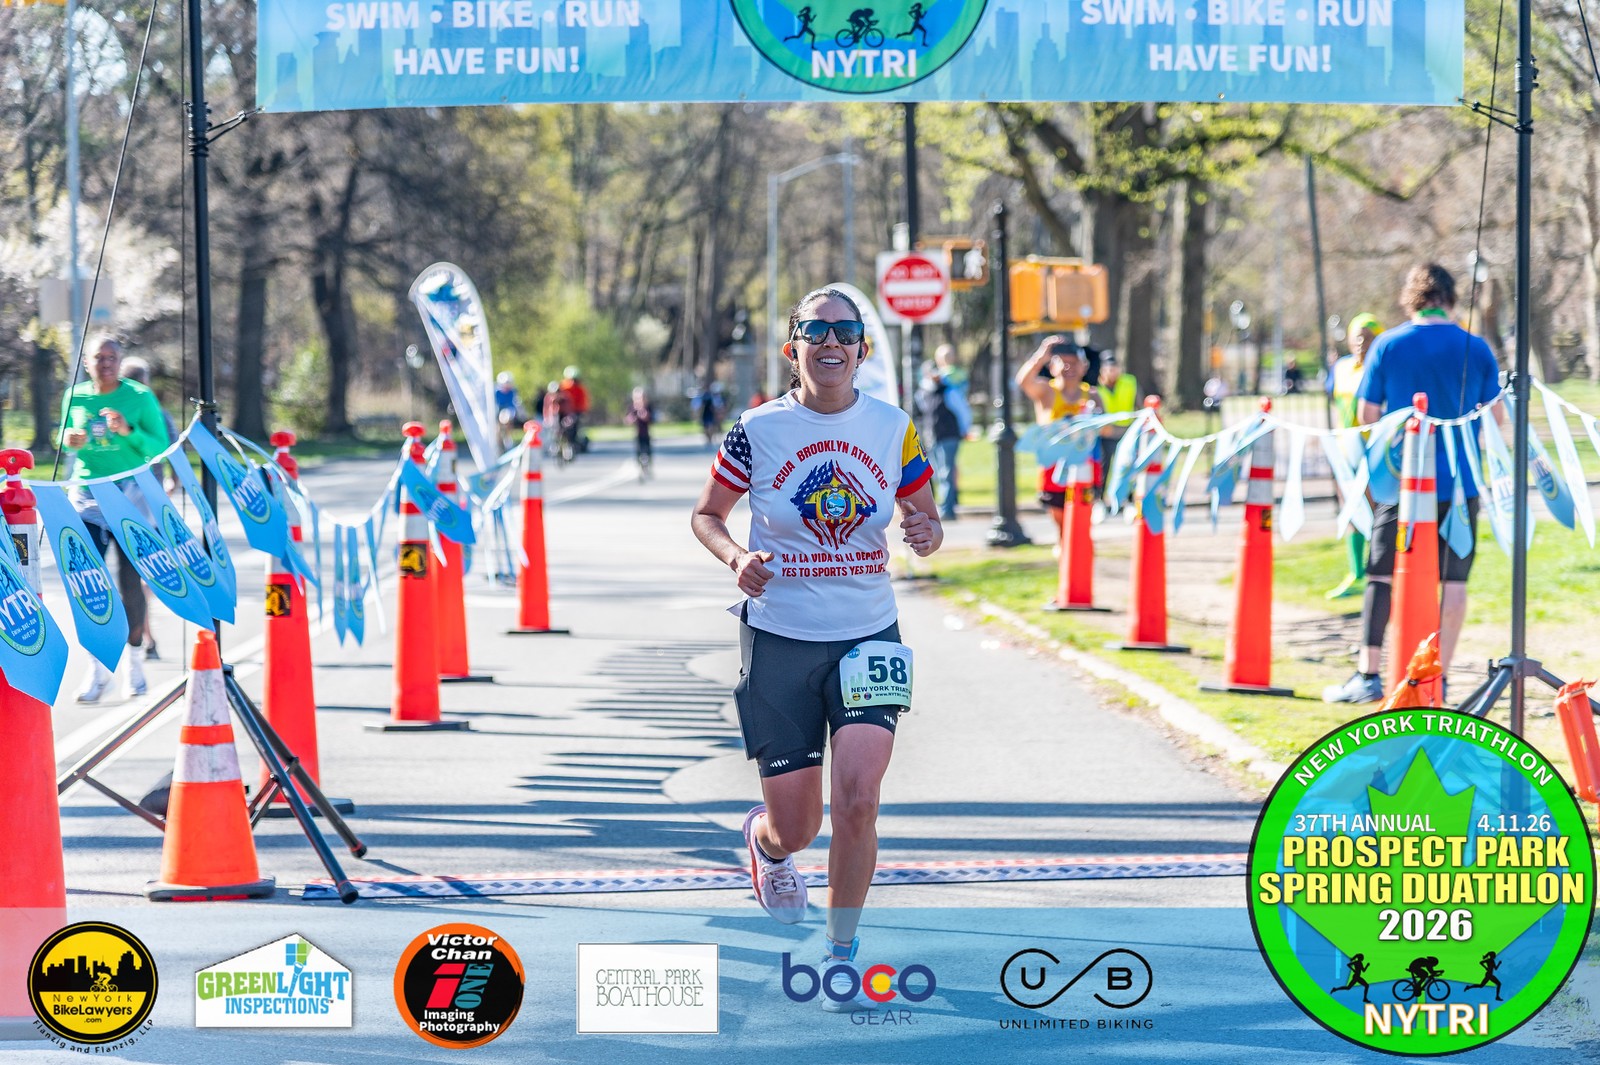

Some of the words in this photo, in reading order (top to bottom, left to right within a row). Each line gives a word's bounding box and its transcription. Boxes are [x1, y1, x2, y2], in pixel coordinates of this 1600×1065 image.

[326, 1, 419, 30] SWIM
[453, 1, 533, 28] BIKE
[566, 0, 640, 28] RUN
[1081, 0, 1175, 25] SWIM
[1207, 0, 1286, 26] BIKE
[1318, 0, 1391, 27] RUN
[394, 48, 485, 75] HAVE
[495, 46, 580, 74] FUN!
[811, 49, 917, 78] NYTRI
[1149, 44, 1238, 71] HAVE
[1249, 45, 1332, 72] FUN!
[772, 460, 796, 491] ECUA
[796, 440, 850, 463] BROOKLYN
[850, 446, 888, 490] ATHLETIC
[135, 547, 179, 581] NYTRI
[781, 567, 797, 577] YES
[799, 567, 810, 577] TO
[812, 566, 848, 577] SPORTS
[849, 565, 864, 576] YES
[865, 564, 873, 574] TO
[791, 554, 797, 563] A
[799, 553, 809, 563] LA
[811, 552, 833, 563] VIDA
[65, 566, 112, 598] NYTRI
[0, 586, 41, 631] YTRI
[868, 656, 907, 684] 58
